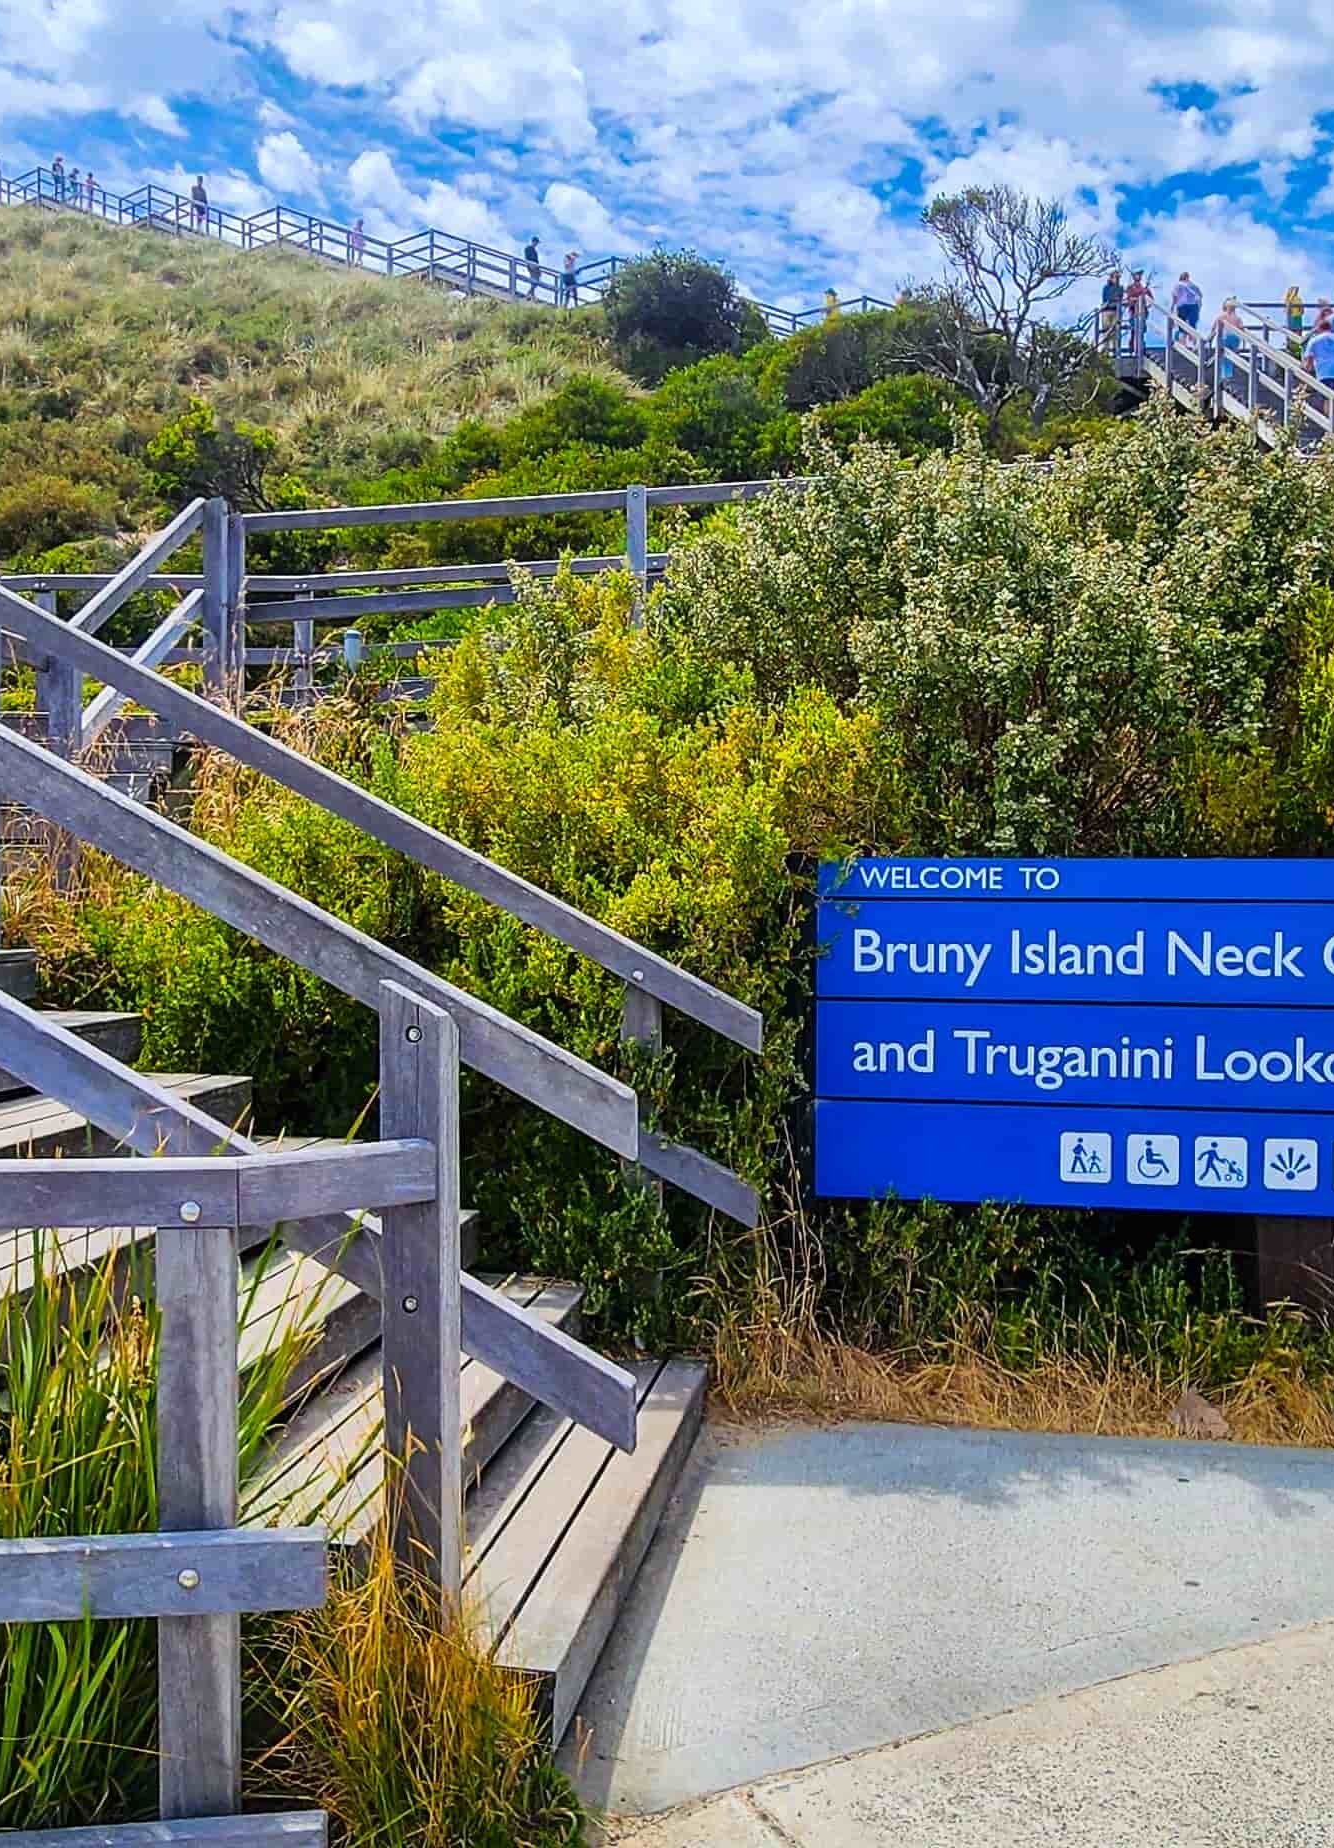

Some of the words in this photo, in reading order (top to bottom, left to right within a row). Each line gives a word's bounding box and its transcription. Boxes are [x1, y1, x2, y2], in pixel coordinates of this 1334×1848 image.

[860, 866, 1003, 889] WELCOME
[1019, 867, 1060, 890] TO
[854, 929, 992, 987] Bruny
[1011, 929, 1144, 975] Island
[1167, 931, 1305, 977] Neck
[853, 1029, 935, 1073] and
[953, 1030, 1173, 1090] Truganini
